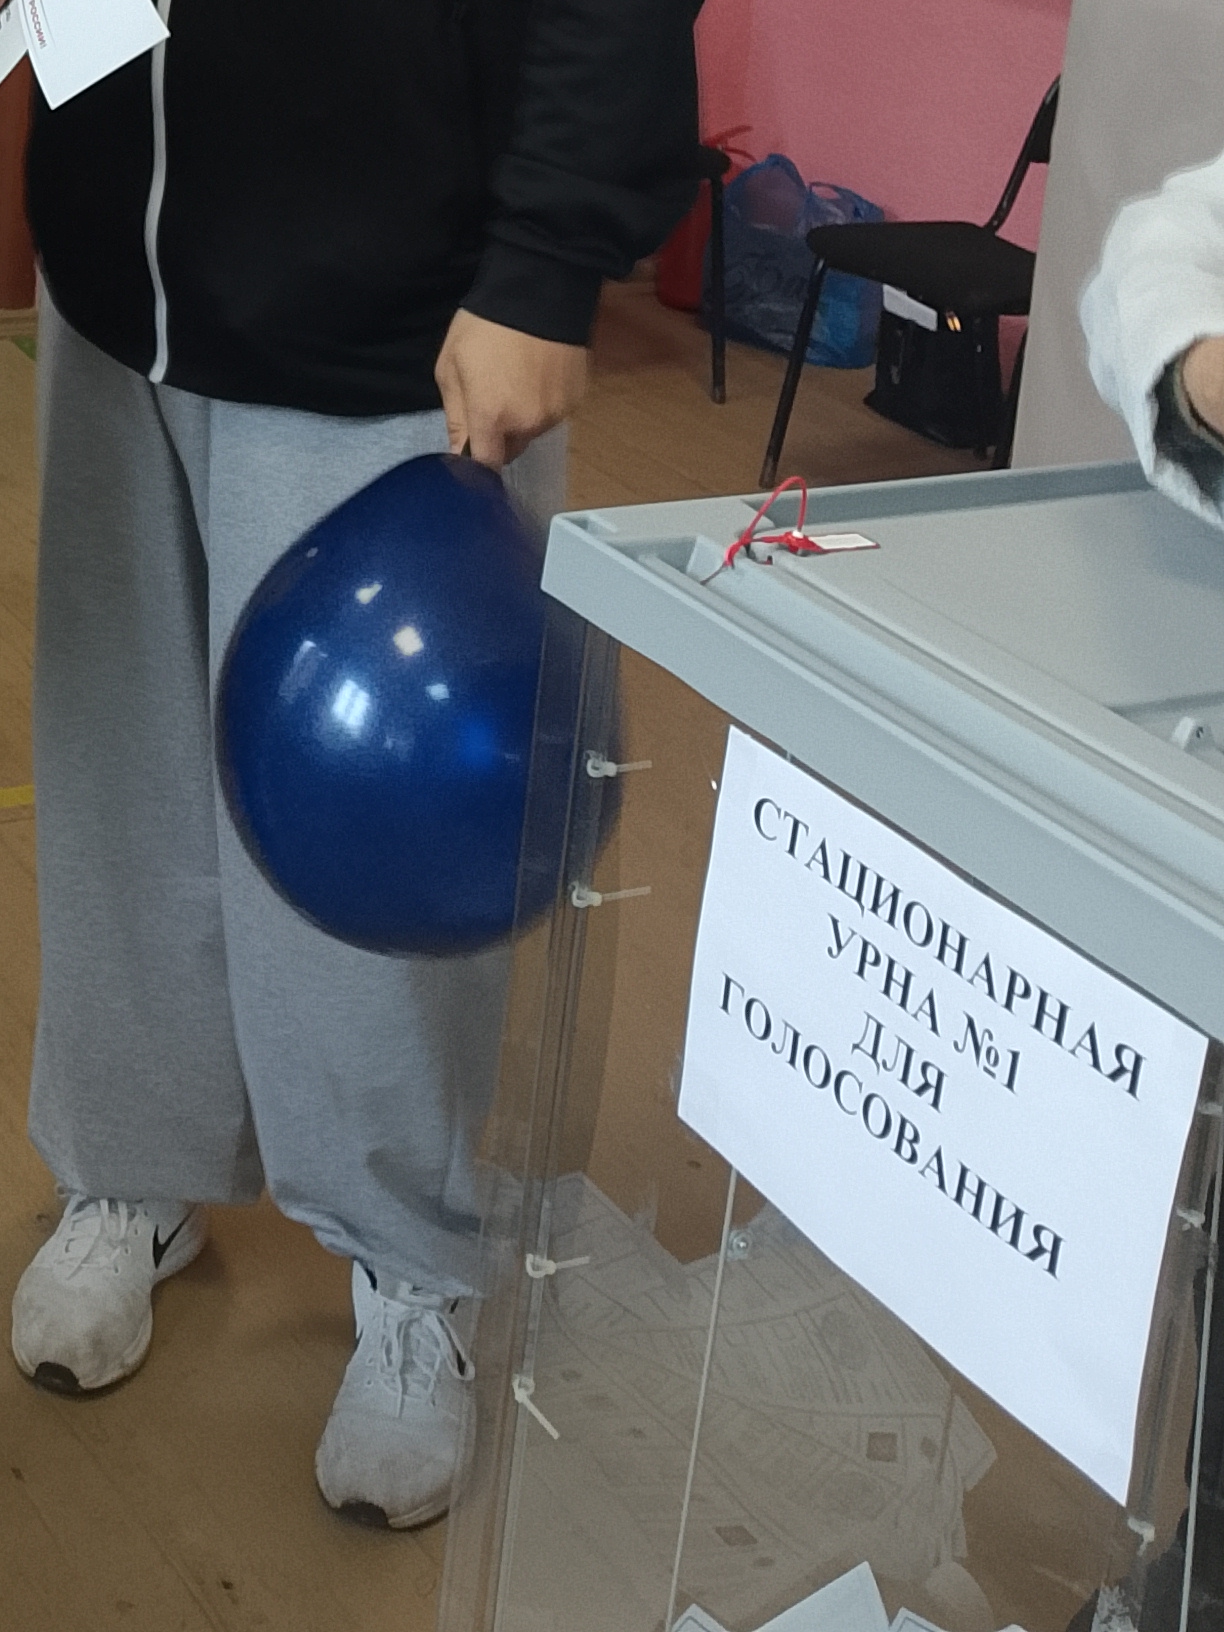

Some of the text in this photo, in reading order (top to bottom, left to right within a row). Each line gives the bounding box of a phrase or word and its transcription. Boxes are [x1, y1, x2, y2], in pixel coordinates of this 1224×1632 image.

[29, 0, 47, 49] РОССИИ!
[753, 797, 1147, 1101] СТАЦИОНАРНАЯ
[827, 913, 1023, 1095] УРНА №1
[719, 971, 1066, 1280] ГОЛОСОВАНИЯ
[851, 1010, 949, 1113] ДЛЯ
